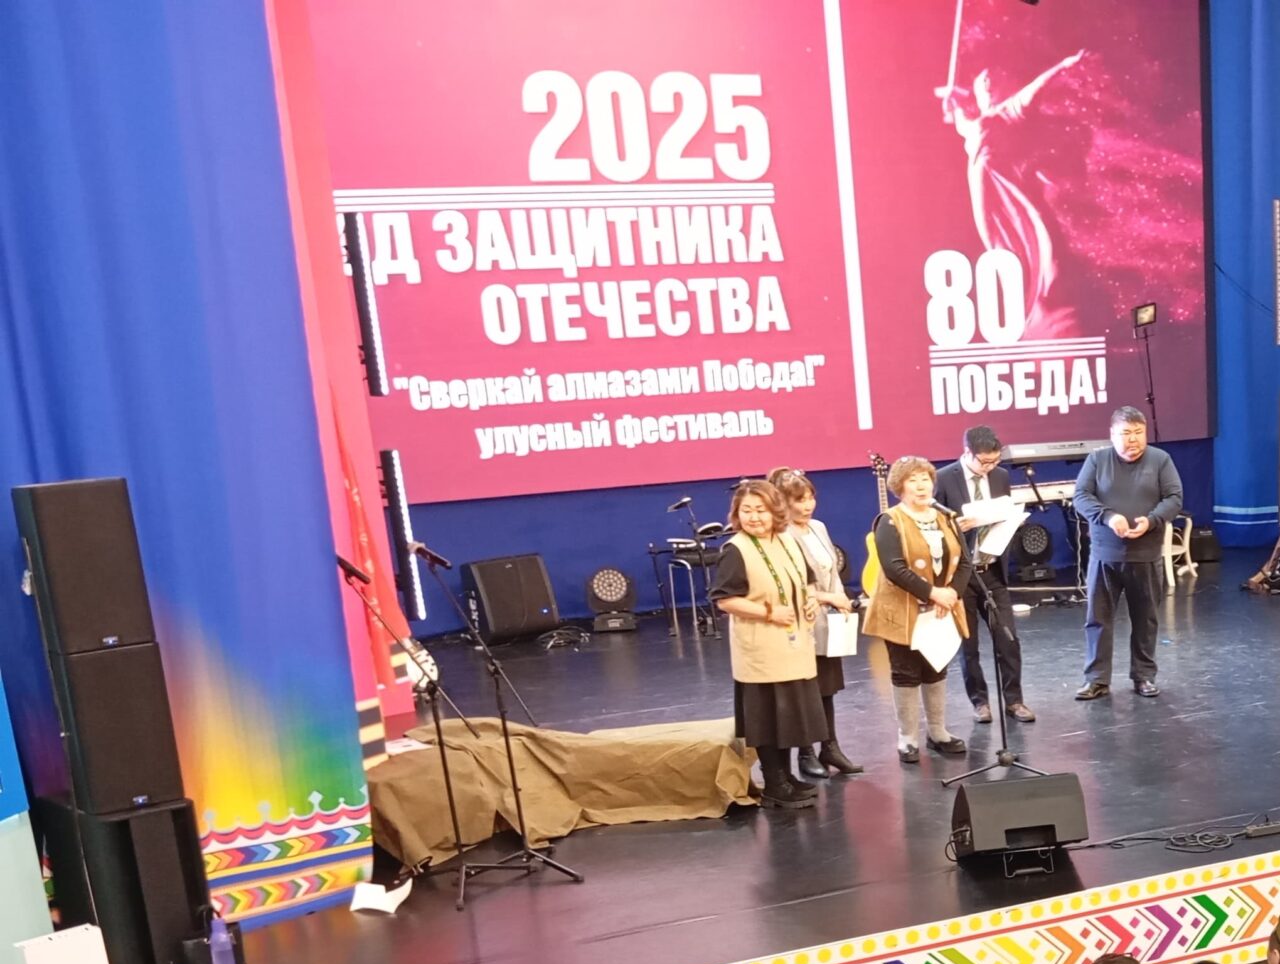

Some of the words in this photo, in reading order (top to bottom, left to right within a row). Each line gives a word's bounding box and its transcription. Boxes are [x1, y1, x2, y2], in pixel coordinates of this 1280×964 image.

[521, 69, 771, 183] 2025
[432, 205, 784, 279] ЗАЩИТНИКА
[480, 276, 791, 346] ОТЕЧЕСТВА
[923, 248, 1026, 347] 80
[393, 368, 544, 411] "Сверкай
[546, 365, 700, 402] алмазами
[702, 354, 826, 394] Победа!"
[930, 357, 1108, 416] ПОБЕДА!
[474, 412, 612, 459] улусный
[615, 409, 775, 448] фестиваль
